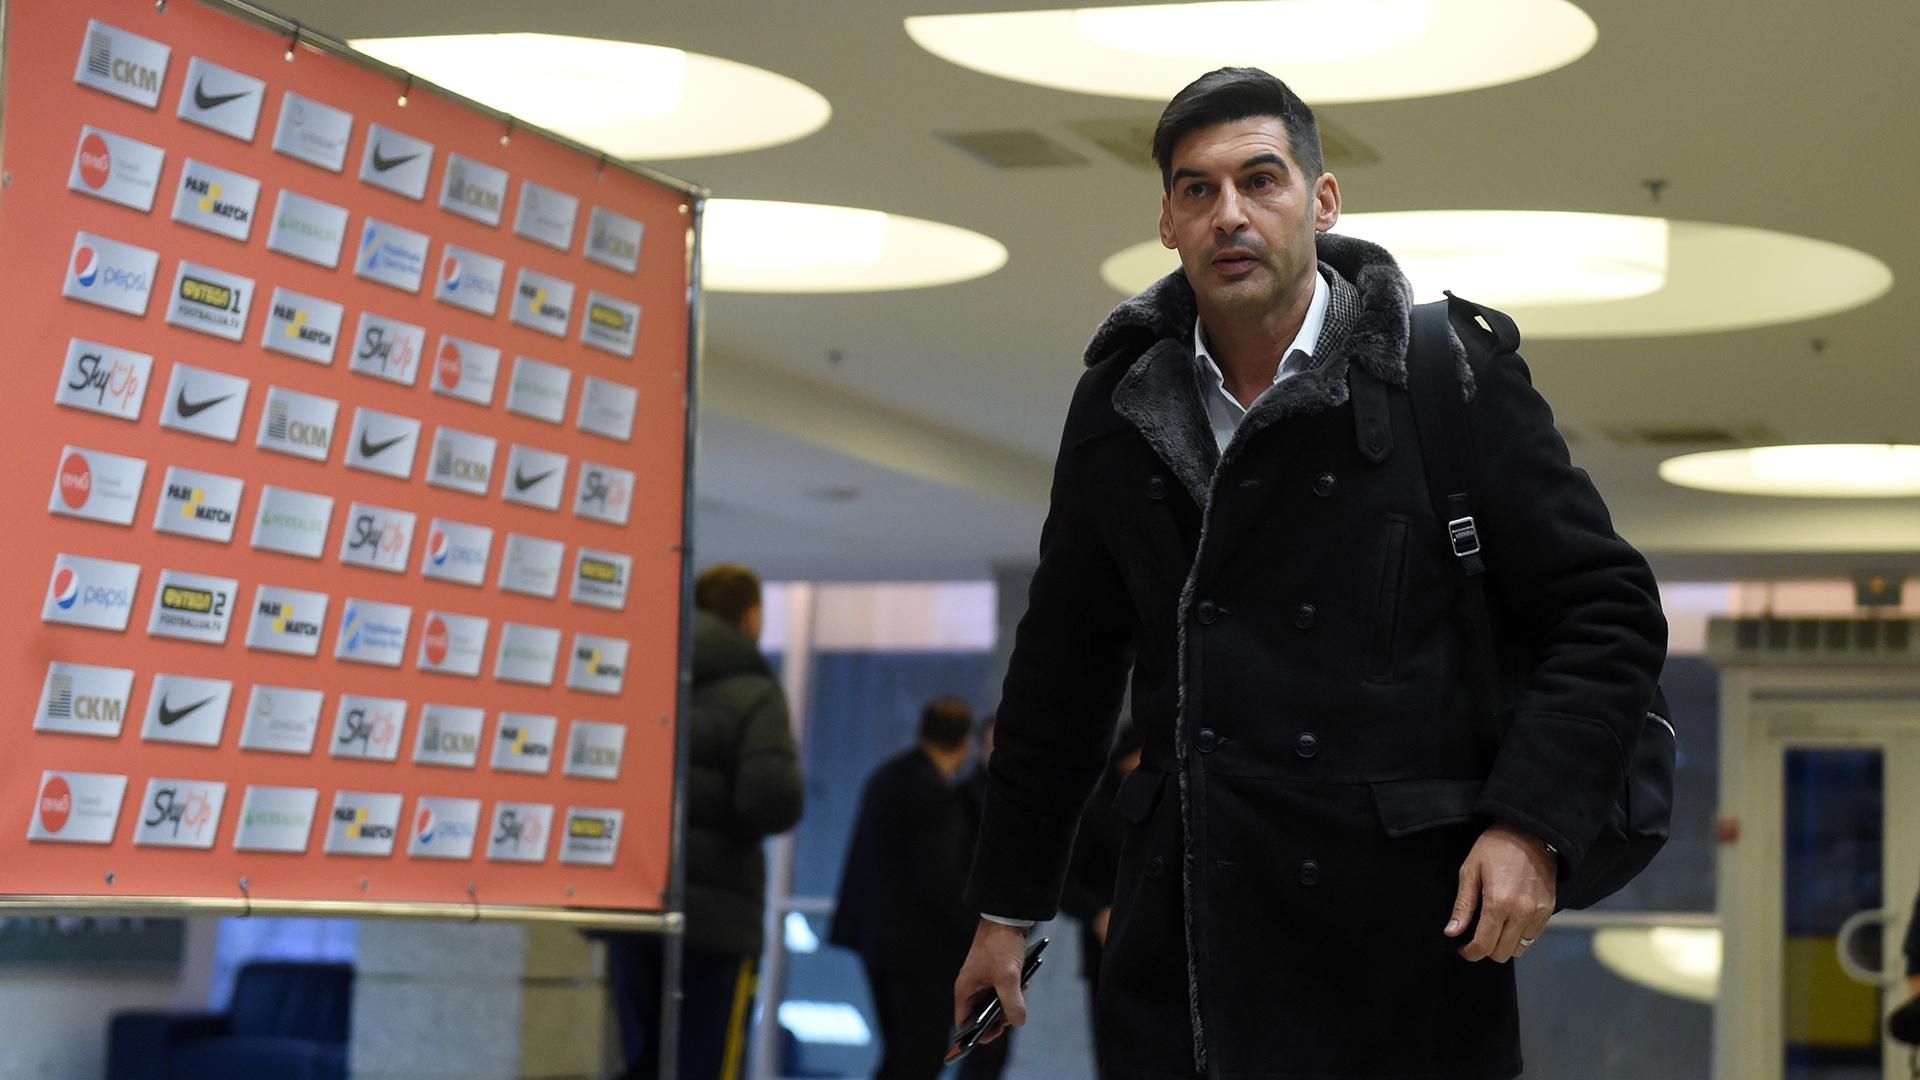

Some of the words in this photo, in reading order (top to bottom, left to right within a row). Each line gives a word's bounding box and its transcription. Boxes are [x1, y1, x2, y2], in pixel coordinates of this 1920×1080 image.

[185, 176, 209, 195] PARI
[212, 200, 249, 223] MATCH
[103, 266, 148, 293] pepsi
[230, 289, 241, 314] 1
[298, 327, 332, 347] MATCH
[168, 484, 192, 501] PARI
[195, 505, 231, 523] MATCH
[83, 584, 129, 608] pepsi
[214, 594, 226, 616] 2
[285, 621, 318, 636] MATCH
